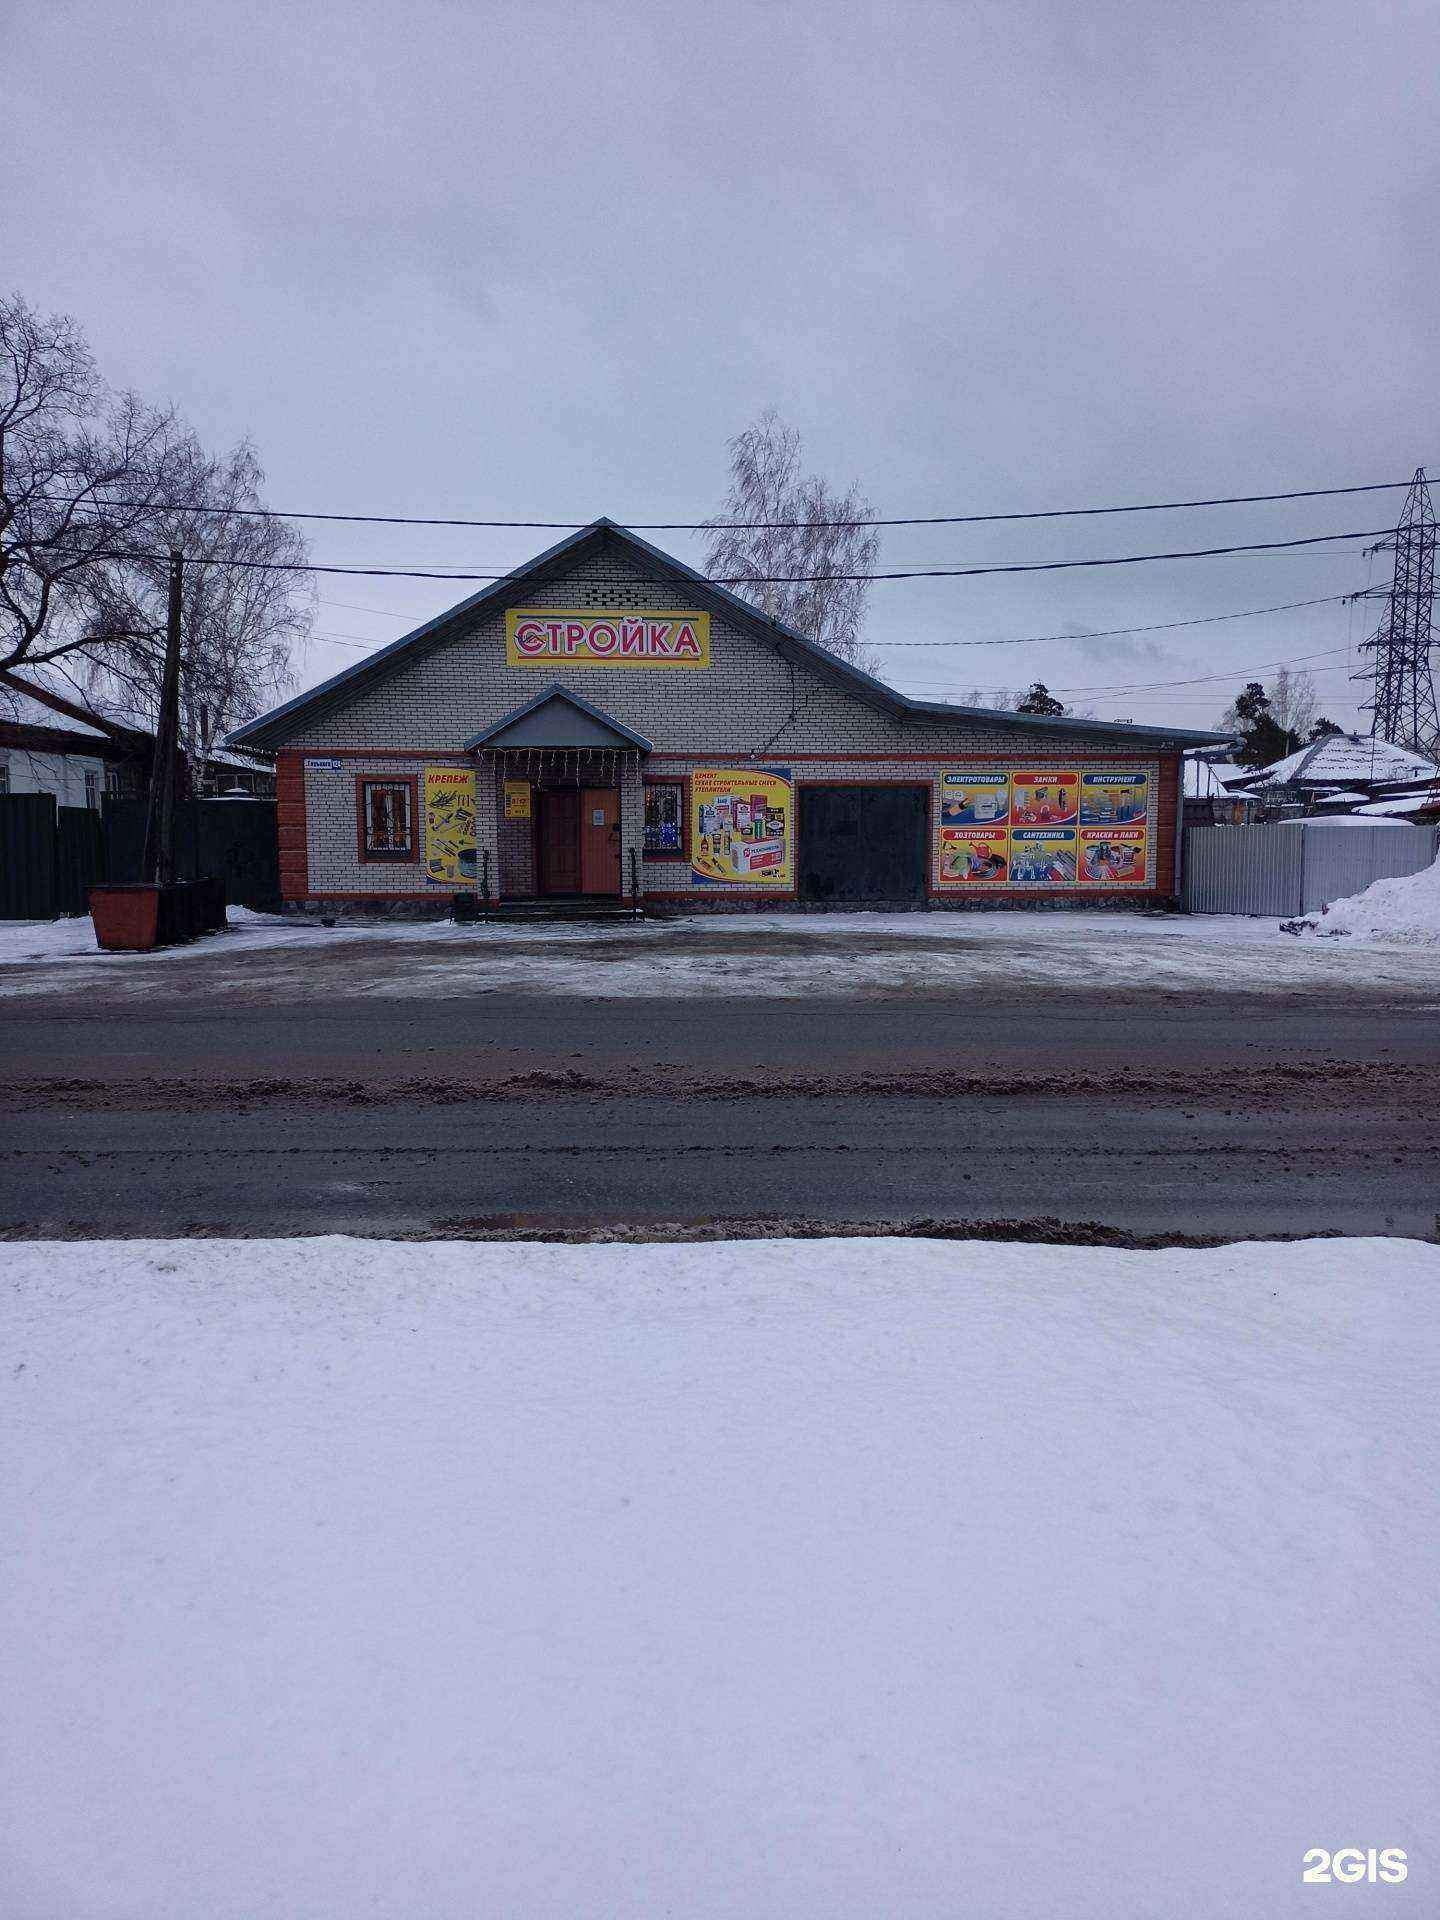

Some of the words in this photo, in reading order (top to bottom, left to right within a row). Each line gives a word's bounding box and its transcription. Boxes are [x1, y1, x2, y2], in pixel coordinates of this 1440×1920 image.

[514, 616, 702, 656] СТРОЙКА
[427, 774, 469, 784] КРЕПЕЖ
[946, 775, 1006, 784] ЭЛЕКТРОТОВАРЫ
[1033, 775, 1059, 784] ЗАМКИ
[1092, 775, 1137, 784] ИНСТРУМЕНТ
[953, 831, 996, 840] ХОЗТОВАРЫ
[1022, 831, 1065, 840] САНТЕХНИКА
[1086, 831, 1113, 840] КРАСКИ
[1119, 831, 1139, 840] ЛАКИ
